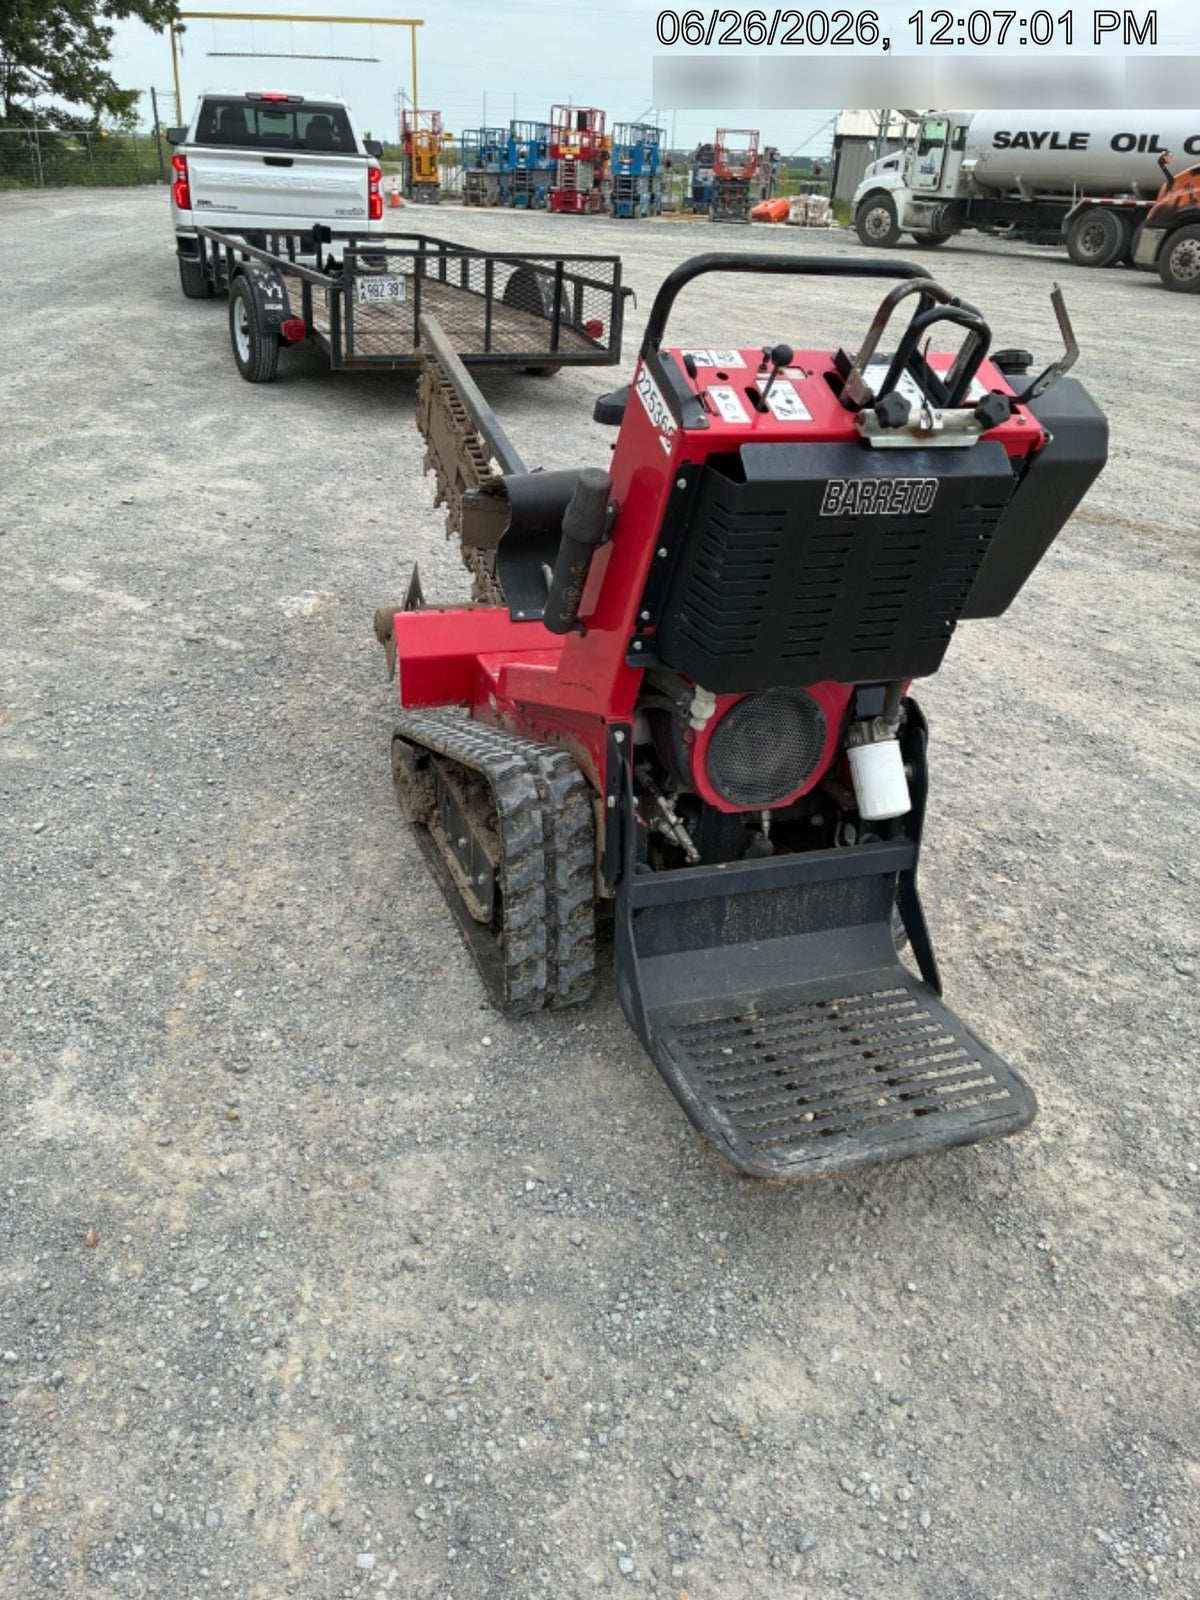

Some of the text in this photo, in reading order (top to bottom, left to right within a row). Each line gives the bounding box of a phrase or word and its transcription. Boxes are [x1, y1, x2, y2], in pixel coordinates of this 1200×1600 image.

[991, 130, 1091, 151] SAYLE
[1110, 132, 1169, 154] OIL
[819, 477, 940, 517] BARRETO
